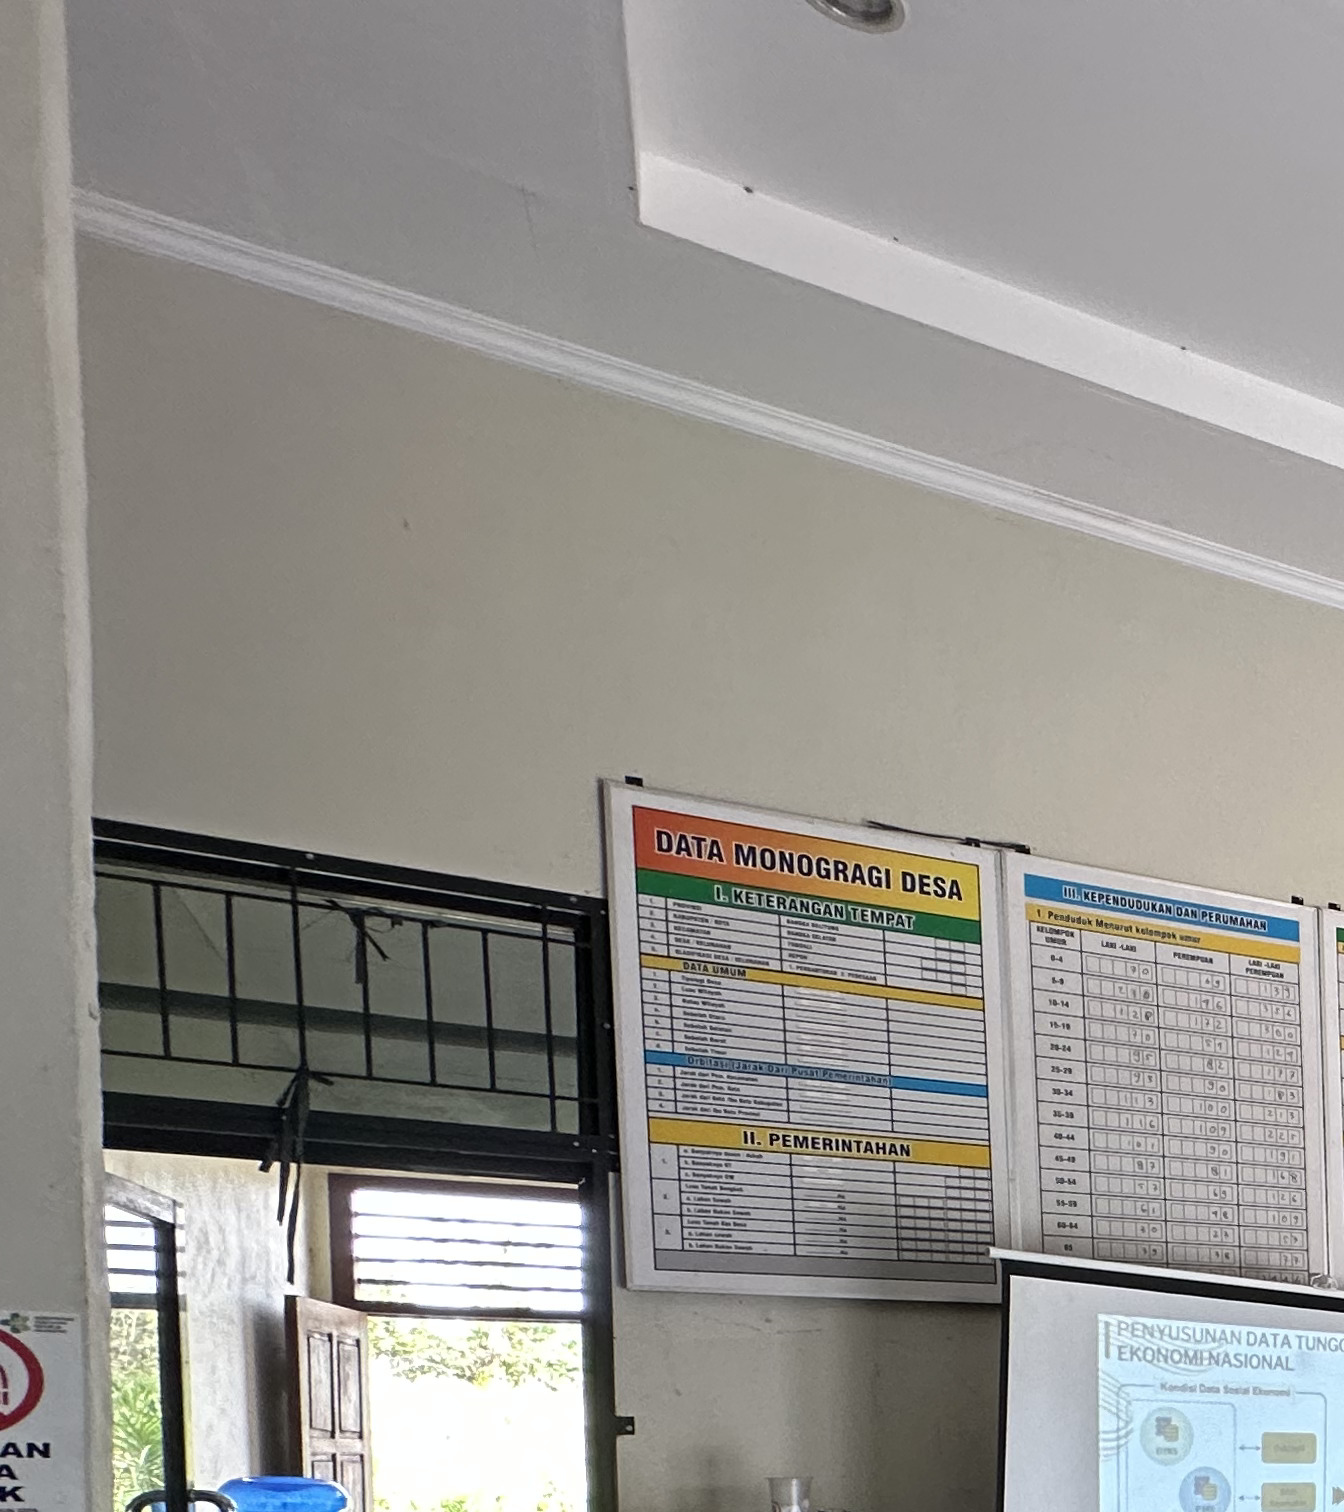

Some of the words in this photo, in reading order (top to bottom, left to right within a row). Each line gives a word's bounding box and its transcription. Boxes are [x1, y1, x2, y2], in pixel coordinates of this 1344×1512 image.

[655, 829, 726, 864] DATA
[733, 842, 891, 890] MONOGRAGI
[900, 870, 963, 902] DESA
[714, 884, 730, 903] I.
[732, 887, 846, 921] KETERANGAN
[849, 905, 916, 931] TEMPAT
[1062, 886, 1079, 899] III.
[1082, 890, 1173, 915] KEPENDUDUKAN
[1176, 906, 1198, 919] DAN
[1200, 910, 1267, 931] PERUMAHAN
[682, 961, 709, 973] DATA
[712, 965, 747, 978] UMUM
[742, 1130, 761, 1146] II.
[768, 1132, 912, 1157] PEMERINTAHAN
[1117, 1320, 1242, 1345] PENYUSUNAN
[1246, 1331, 1292, 1349] DATA
[1117, 1345, 1204, 1367] EKONOMI
[1208, 1352, 1296, 1372] NASIONAL
[1160, 1382, 1197, 1393] Kondisi
[1200, 1383, 1220, 1394] Data
[1223, 1385, 1250, 1395] Sosial
